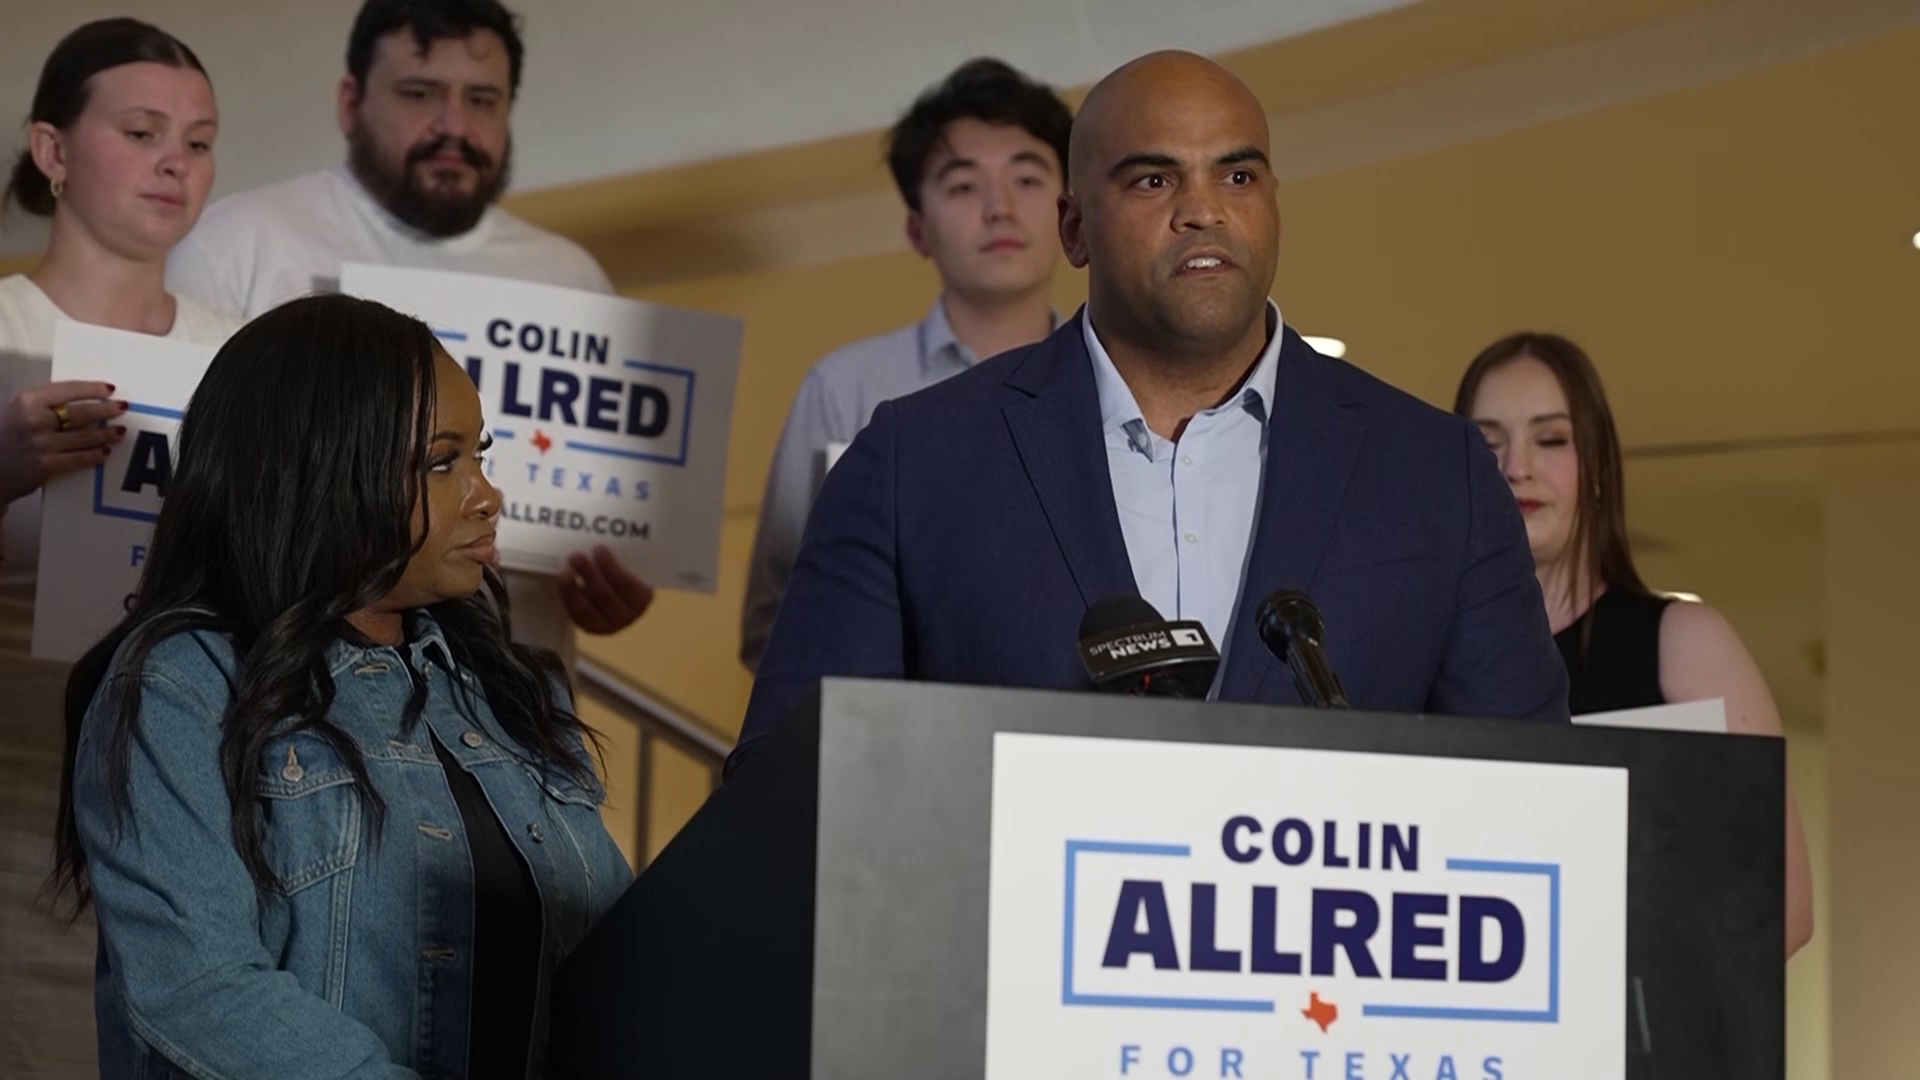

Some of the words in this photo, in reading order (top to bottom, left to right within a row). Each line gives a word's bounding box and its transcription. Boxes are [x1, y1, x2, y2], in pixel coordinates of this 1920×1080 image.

[486, 318, 609, 366] COLIN
[527, 463, 650, 499] TEXAS
[1089, 631, 1167, 656] SPECTRUM
[1110, 639, 1171, 659] NEWS
[1221, 815, 1420, 872] COLIN
[1100, 879, 1526, 983] ALLRED
[1120, 1044, 1245, 1079] FOR
[1300, 1050, 1504, 1080] TEXAS
